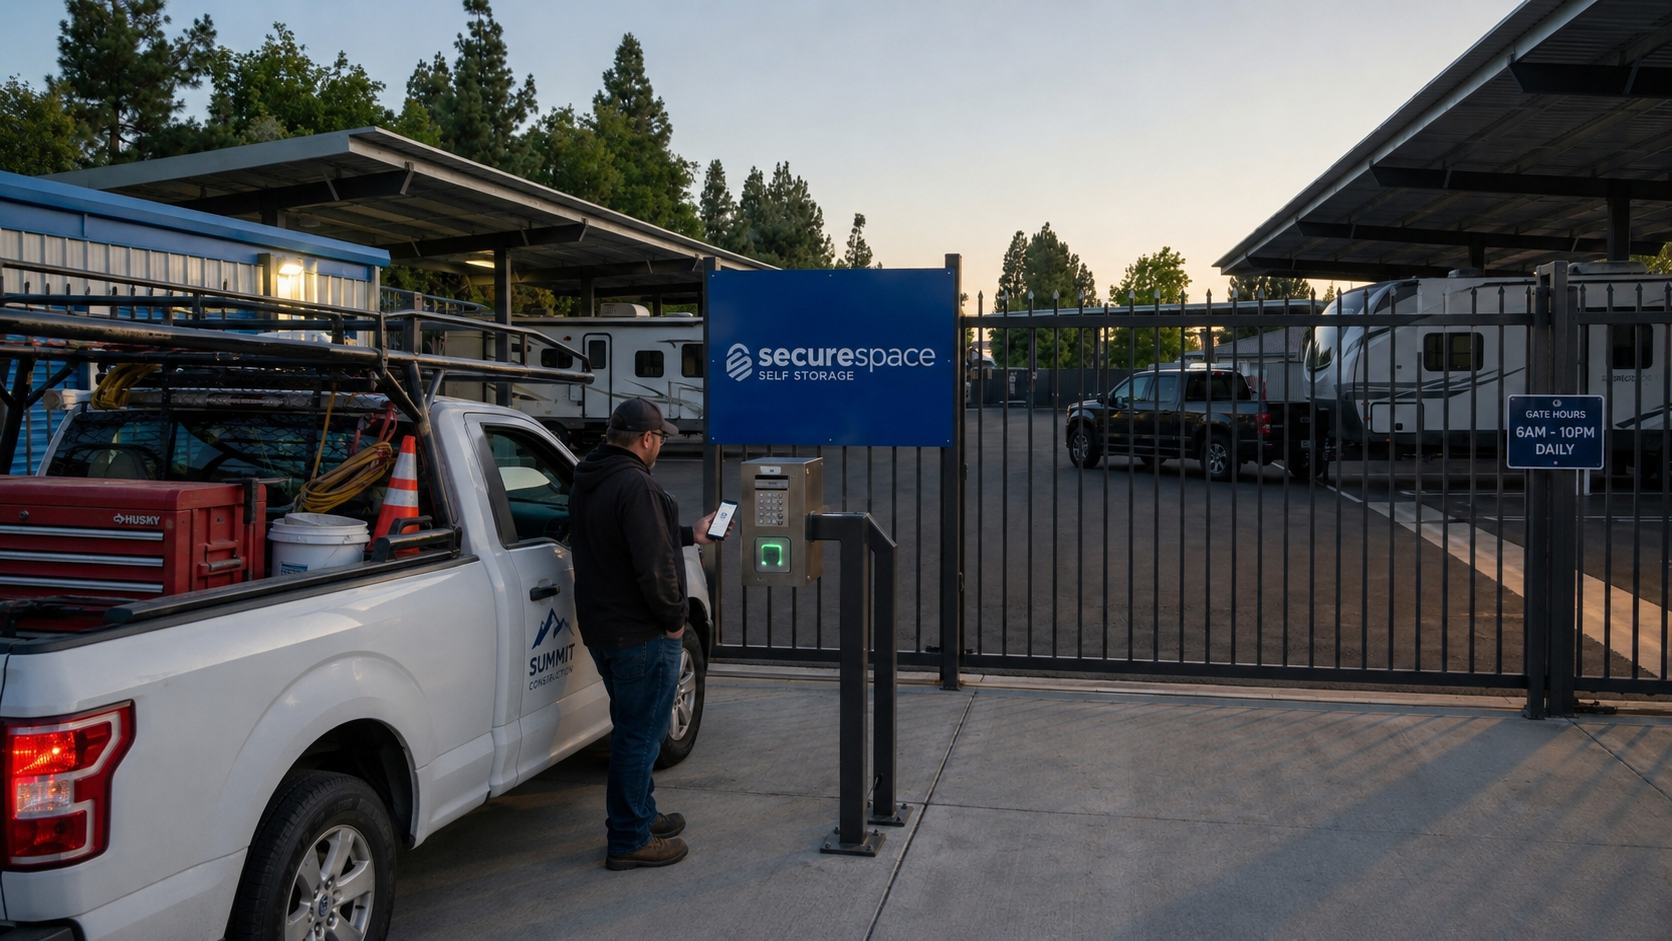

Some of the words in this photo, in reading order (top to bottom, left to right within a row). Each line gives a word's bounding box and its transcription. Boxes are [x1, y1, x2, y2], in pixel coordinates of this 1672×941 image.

[758, 347, 936, 373] securespace
[758, 370, 789, 381] SELF
[794, 370, 854, 381] STORAGE
[1525, 410, 1550, 419] GATE
[1552, 410, 1586, 419] HOURS
[1516, 426, 1546, 438] 6AM
[1560, 426, 1595, 438] 10PM
[1535, 443, 1575, 455] DAILY
[125, 514, 160, 525] HUSKY
[529, 643, 575, 676] SUMMIT
